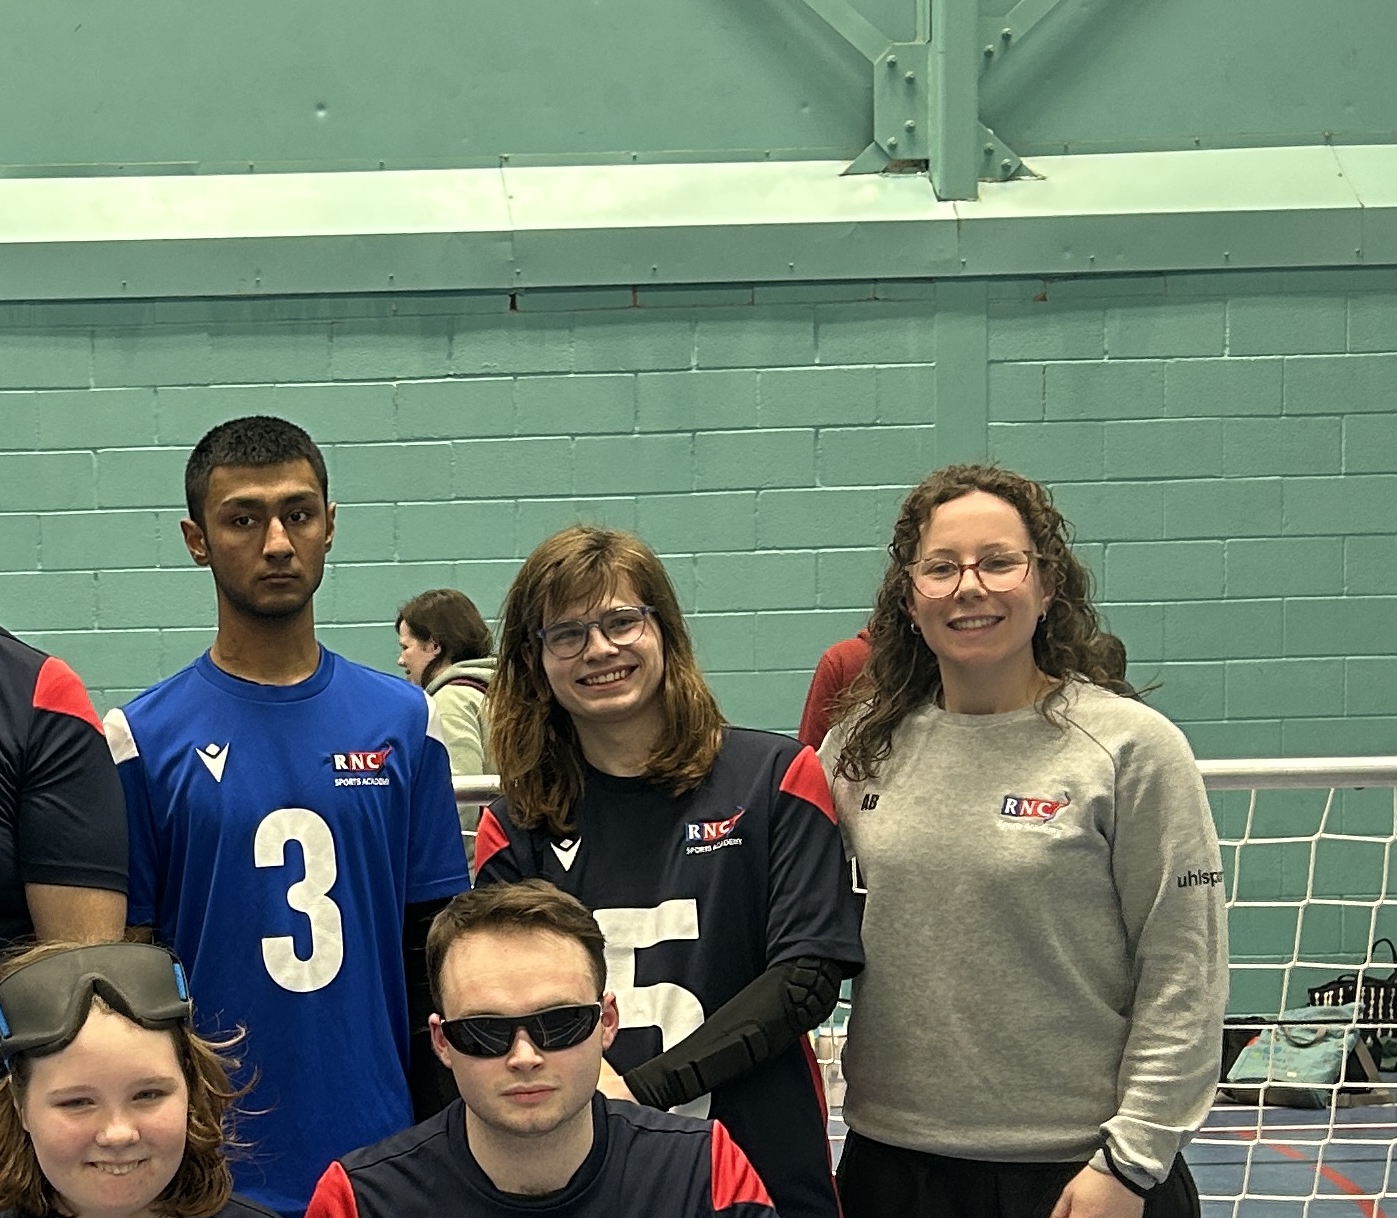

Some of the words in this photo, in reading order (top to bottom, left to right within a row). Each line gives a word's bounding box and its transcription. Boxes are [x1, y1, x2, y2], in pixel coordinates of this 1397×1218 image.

[334, 754, 380, 771] RNC
[334, 777, 362, 787] SPORTS
[860, 793, 880, 811] AB
[1004, 798, 1051, 817] RNC
[688, 820, 731, 840] RNC
[253, 808, 345, 993] 3
[593, 898, 711, 1119] 5
